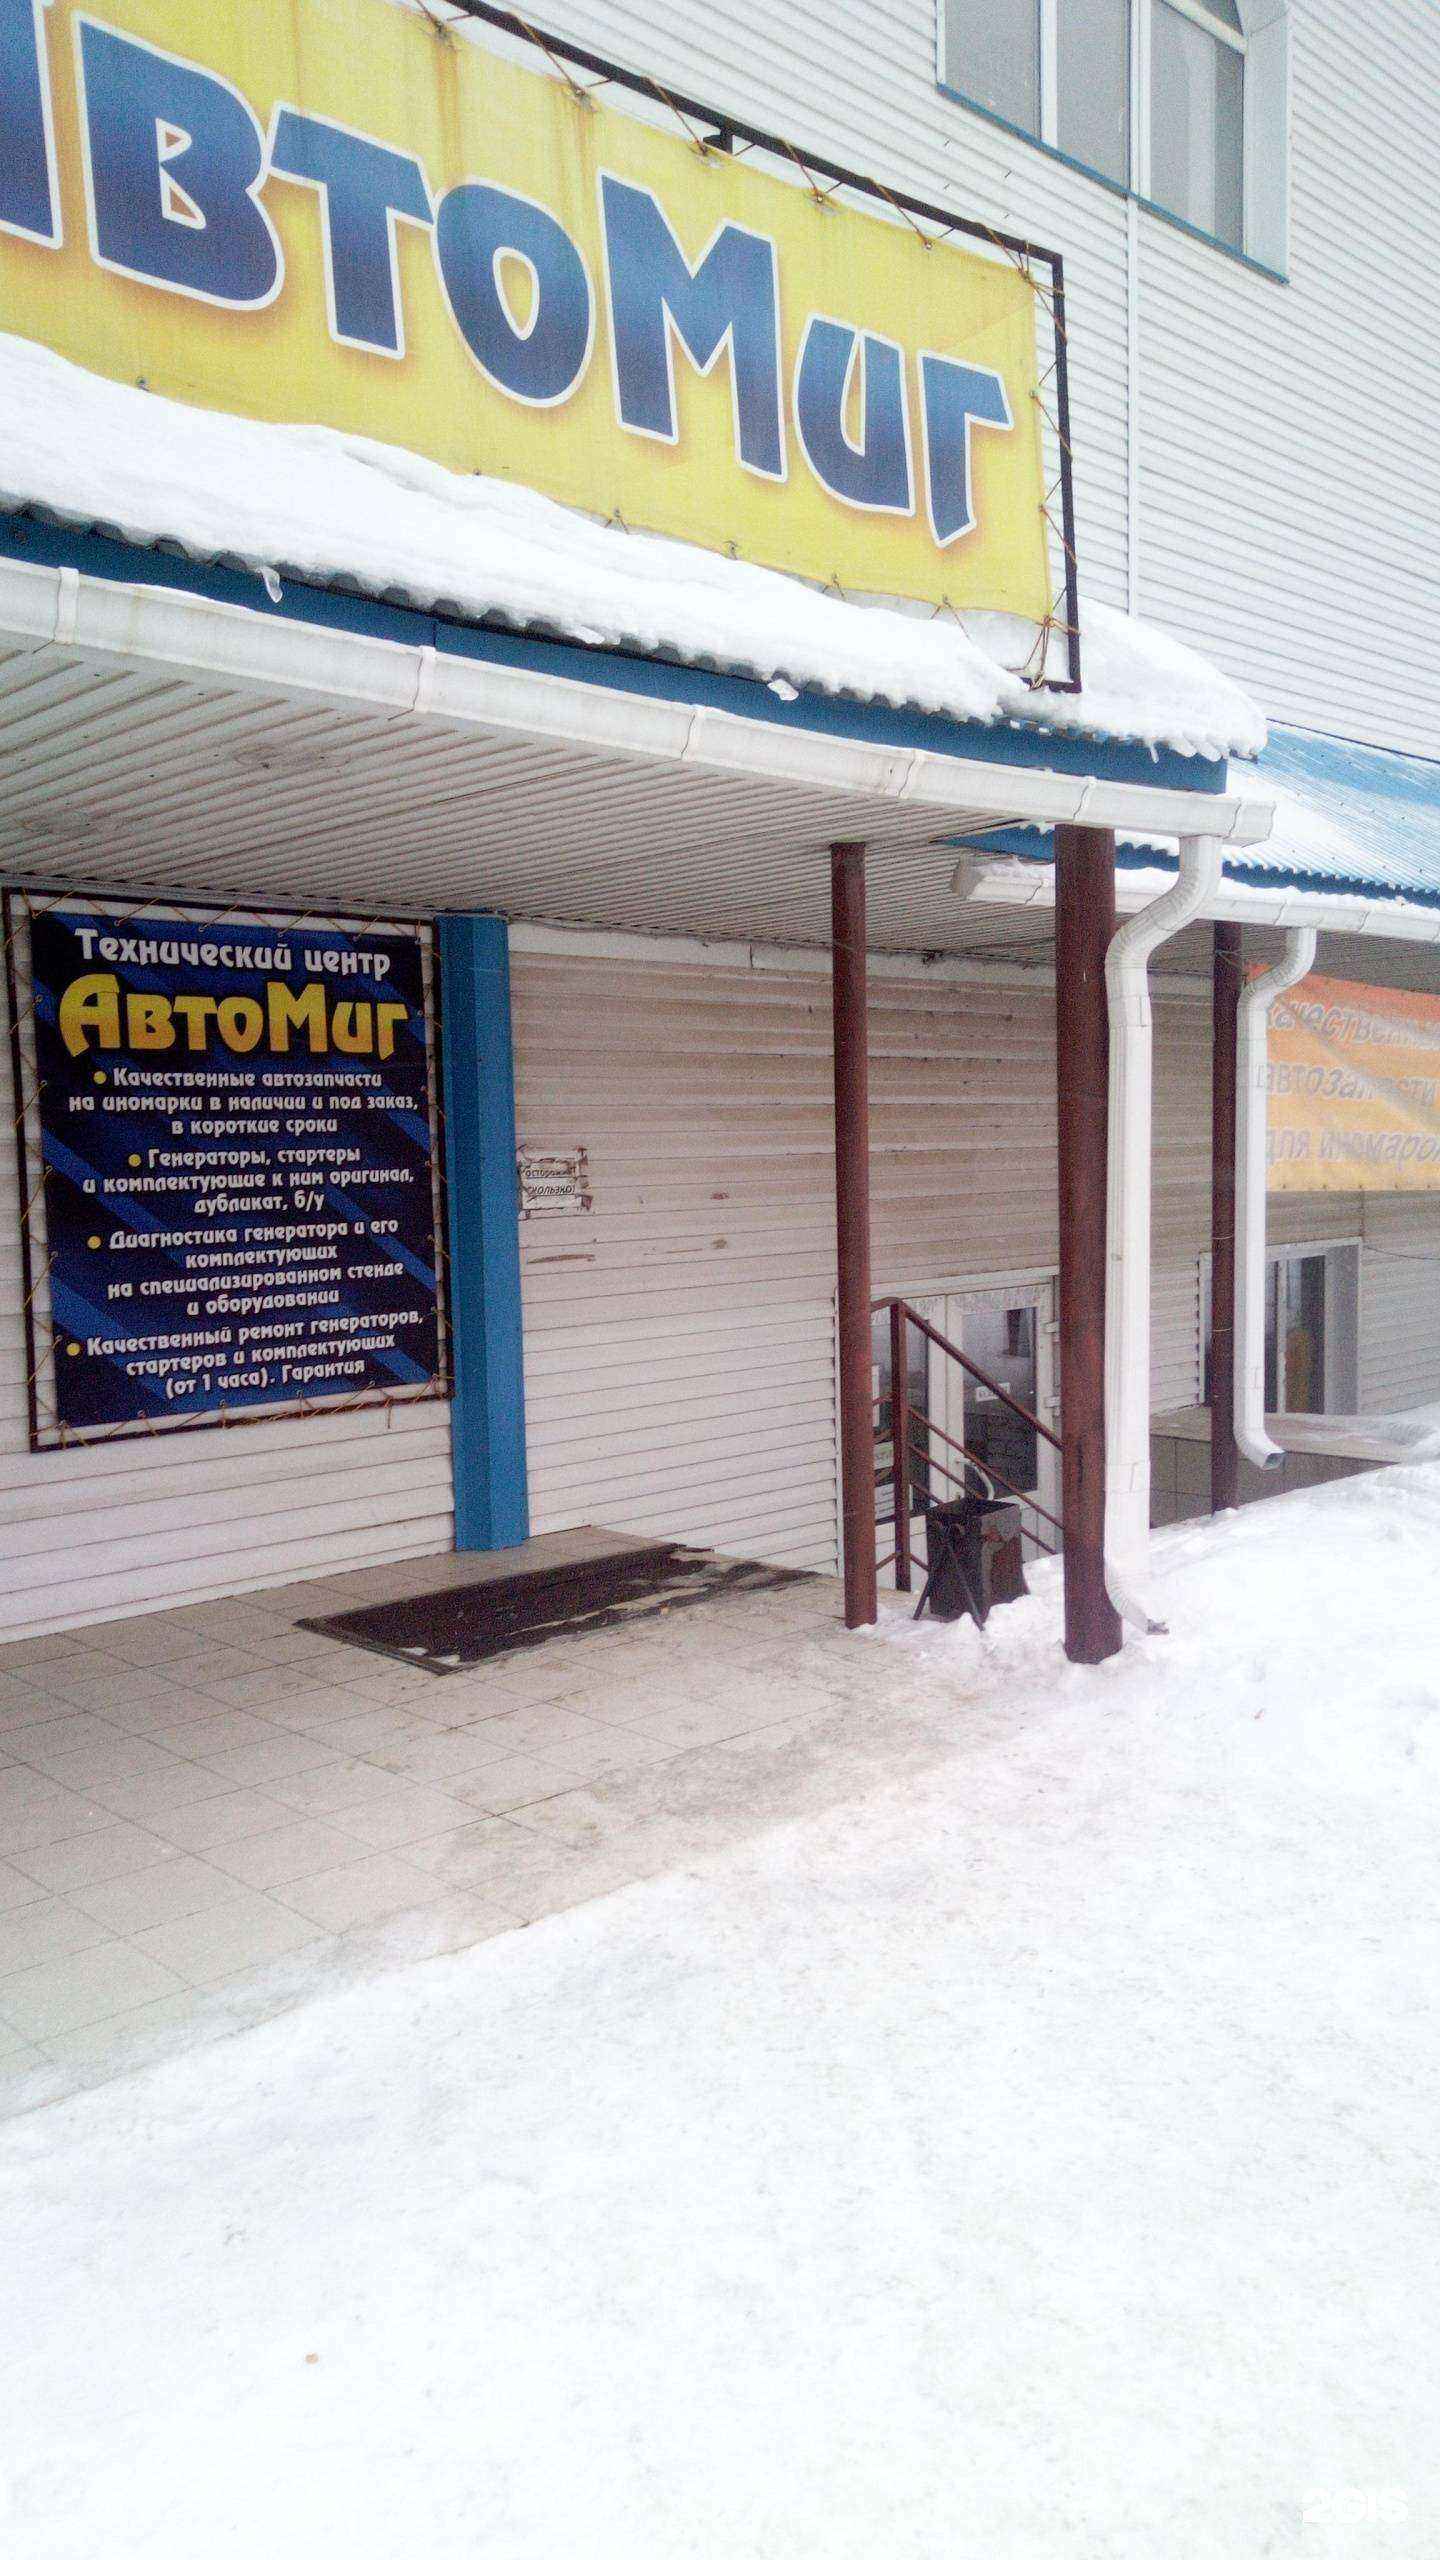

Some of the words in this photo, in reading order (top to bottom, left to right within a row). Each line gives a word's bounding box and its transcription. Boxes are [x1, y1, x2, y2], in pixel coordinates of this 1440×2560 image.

[74, 928, 292, 971] Технический
[304, 949, 391, 981] центр
[59, 973, 408, 1060] АвтоМиг
[113, 1067, 256, 1088] Качественные
[262, 1073, 382, 1087] автозапчасти
[69, 1096, 95, 1112] на
[102, 1096, 202, 1114] иномарки
[209, 1096, 222, 1110] в
[228, 1096, 306, 1111] наличии
[312, 1096, 323, 1109] и
[329, 1096, 362, 1109] под
[366, 1096, 418, 1110] заказ,
[171, 1120, 184, 1134] в
[190, 1119, 280, 1137] короткие
[286, 1118, 338, 1136] сроки
[148, 1149, 272, 1169] Генераторы,
[277, 1148, 361, 1166] стартеры
[83, 1179, 96, 1193] и
[103, 1174, 266, 1193] комплектующие
[272, 1173, 283, 1186] к
[289, 1171, 324, 1187] ним
[329, 1169, 414, 1187] оригинал,
[194, 1193, 288, 1216] дубликат,
[294, 1190, 325, 1211] б/у
[109, 1229, 237, 1249] Диагностика
[244, 1222, 348, 1242] генератора
[354, 1221, 365, 1234] и
[370, 1220, 399, 1234] его
[185, 1245, 338, 1269] комплектующих
[107, 1282, 133, 1299] на
[140, 1267, 342, 1295] специализированном
[347, 1262, 404, 1279] стенде
[187, 1301, 199, 1316] и
[205, 1290, 340, 1315] оборудовании
[86, 1327, 232, 1356] Качественный
[238, 1321, 304, 1345] ремонт
[310, 1311, 424, 1335] генераторов,
[126, 1352, 227, 1377] стартеров
[233, 1350, 245, 1364] и
[252, 1334, 396, 1363] комплектующих
[165, 1377, 197, 1399] (от
[202, 1373, 211, 1391] 1
[217, 1367, 276, 1388] часа).
[282, 1360, 365, 1383] Гарантия
